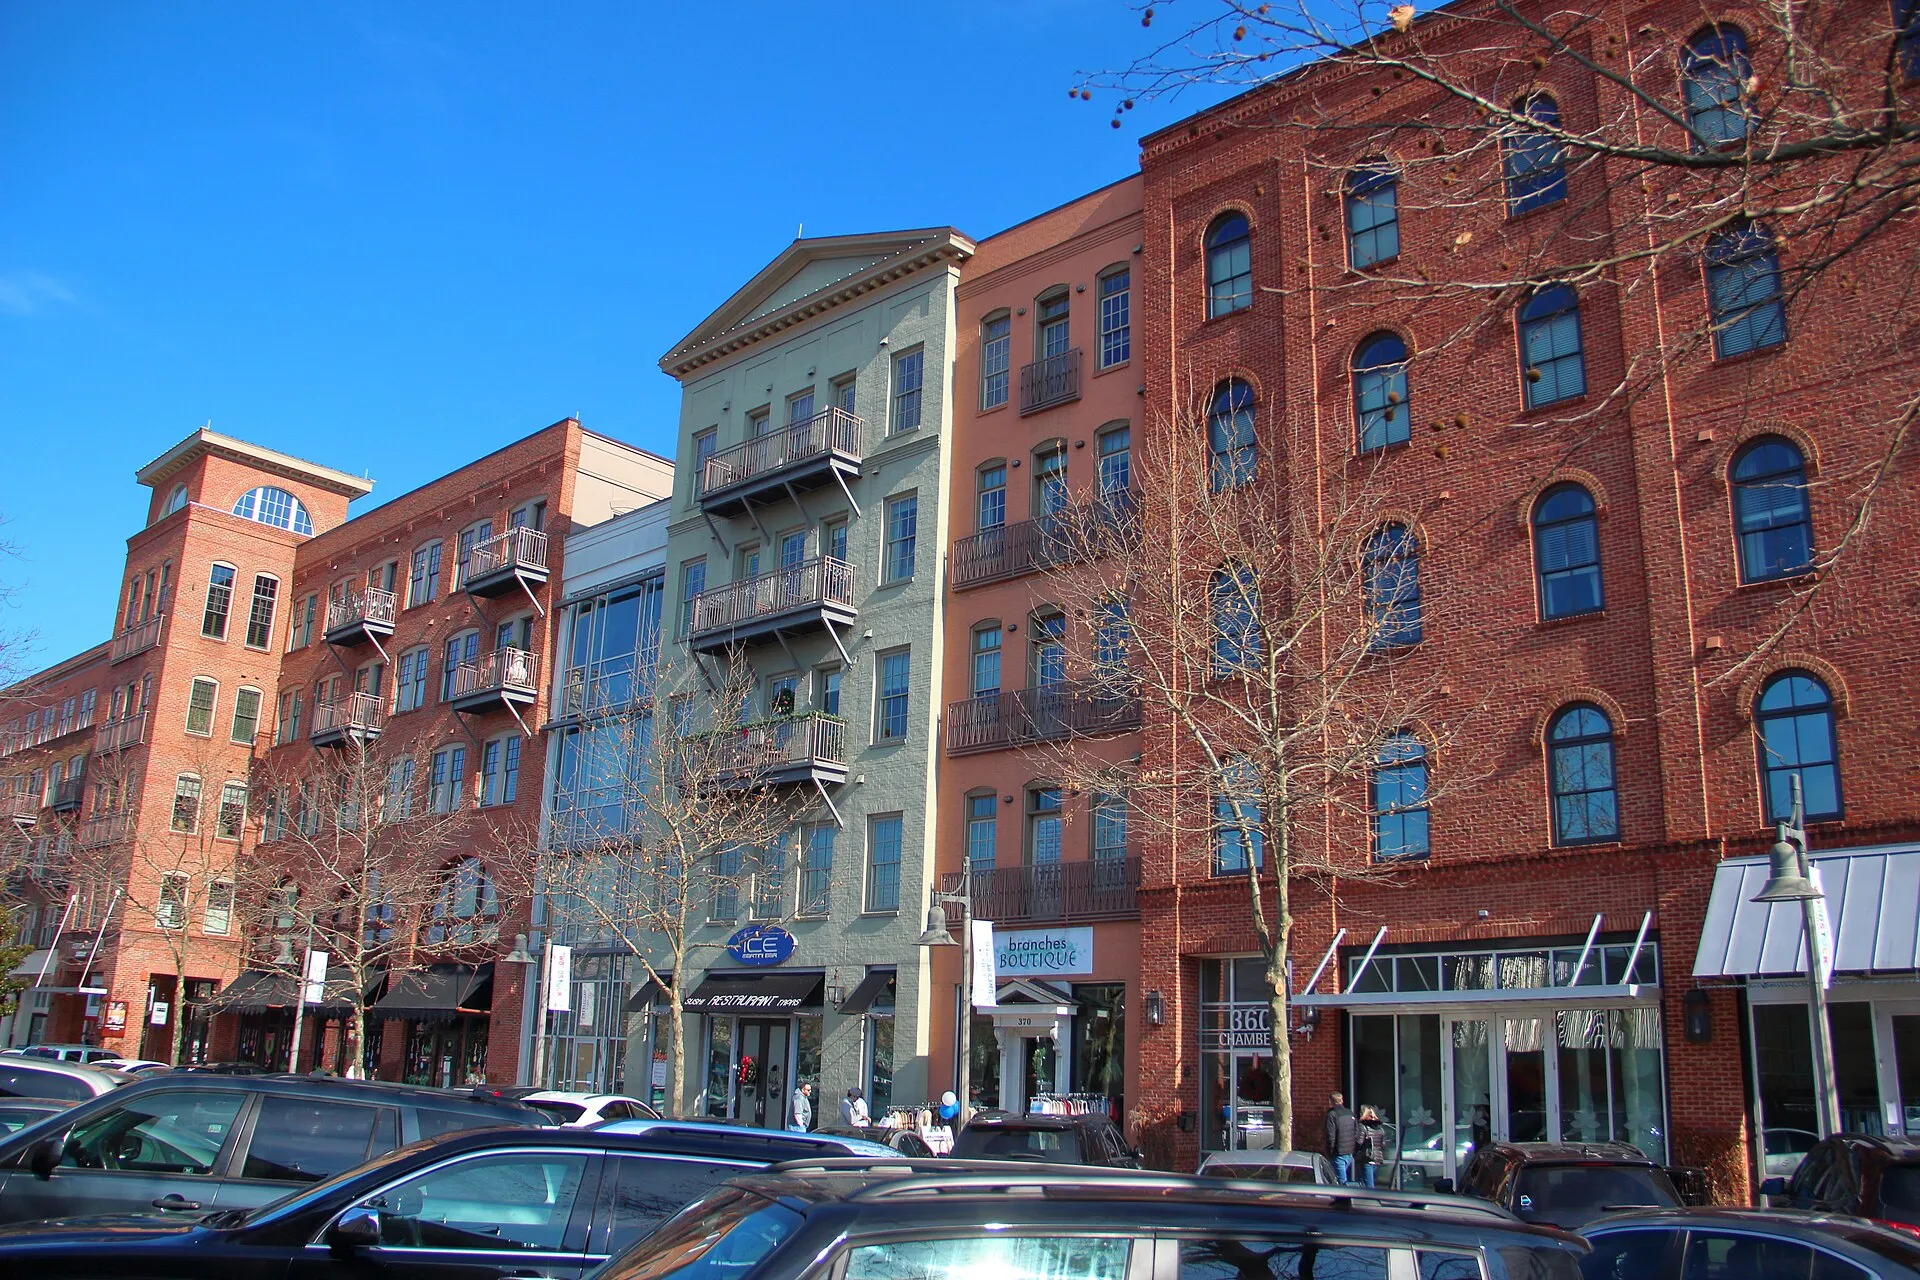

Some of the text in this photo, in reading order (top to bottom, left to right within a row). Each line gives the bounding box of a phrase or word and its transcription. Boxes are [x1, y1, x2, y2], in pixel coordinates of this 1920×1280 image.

[743, 937, 778, 953] ICE
[1009, 935, 1067, 952] branches
[1000, 951, 1076, 970] BOUTIQUE
[684, 995, 802, 1007] SUSHI RESTAURANT TAPAS
[1018, 1017, 1032, 1026] 370
[1219, 1032, 1271, 1046] CHAMBE
